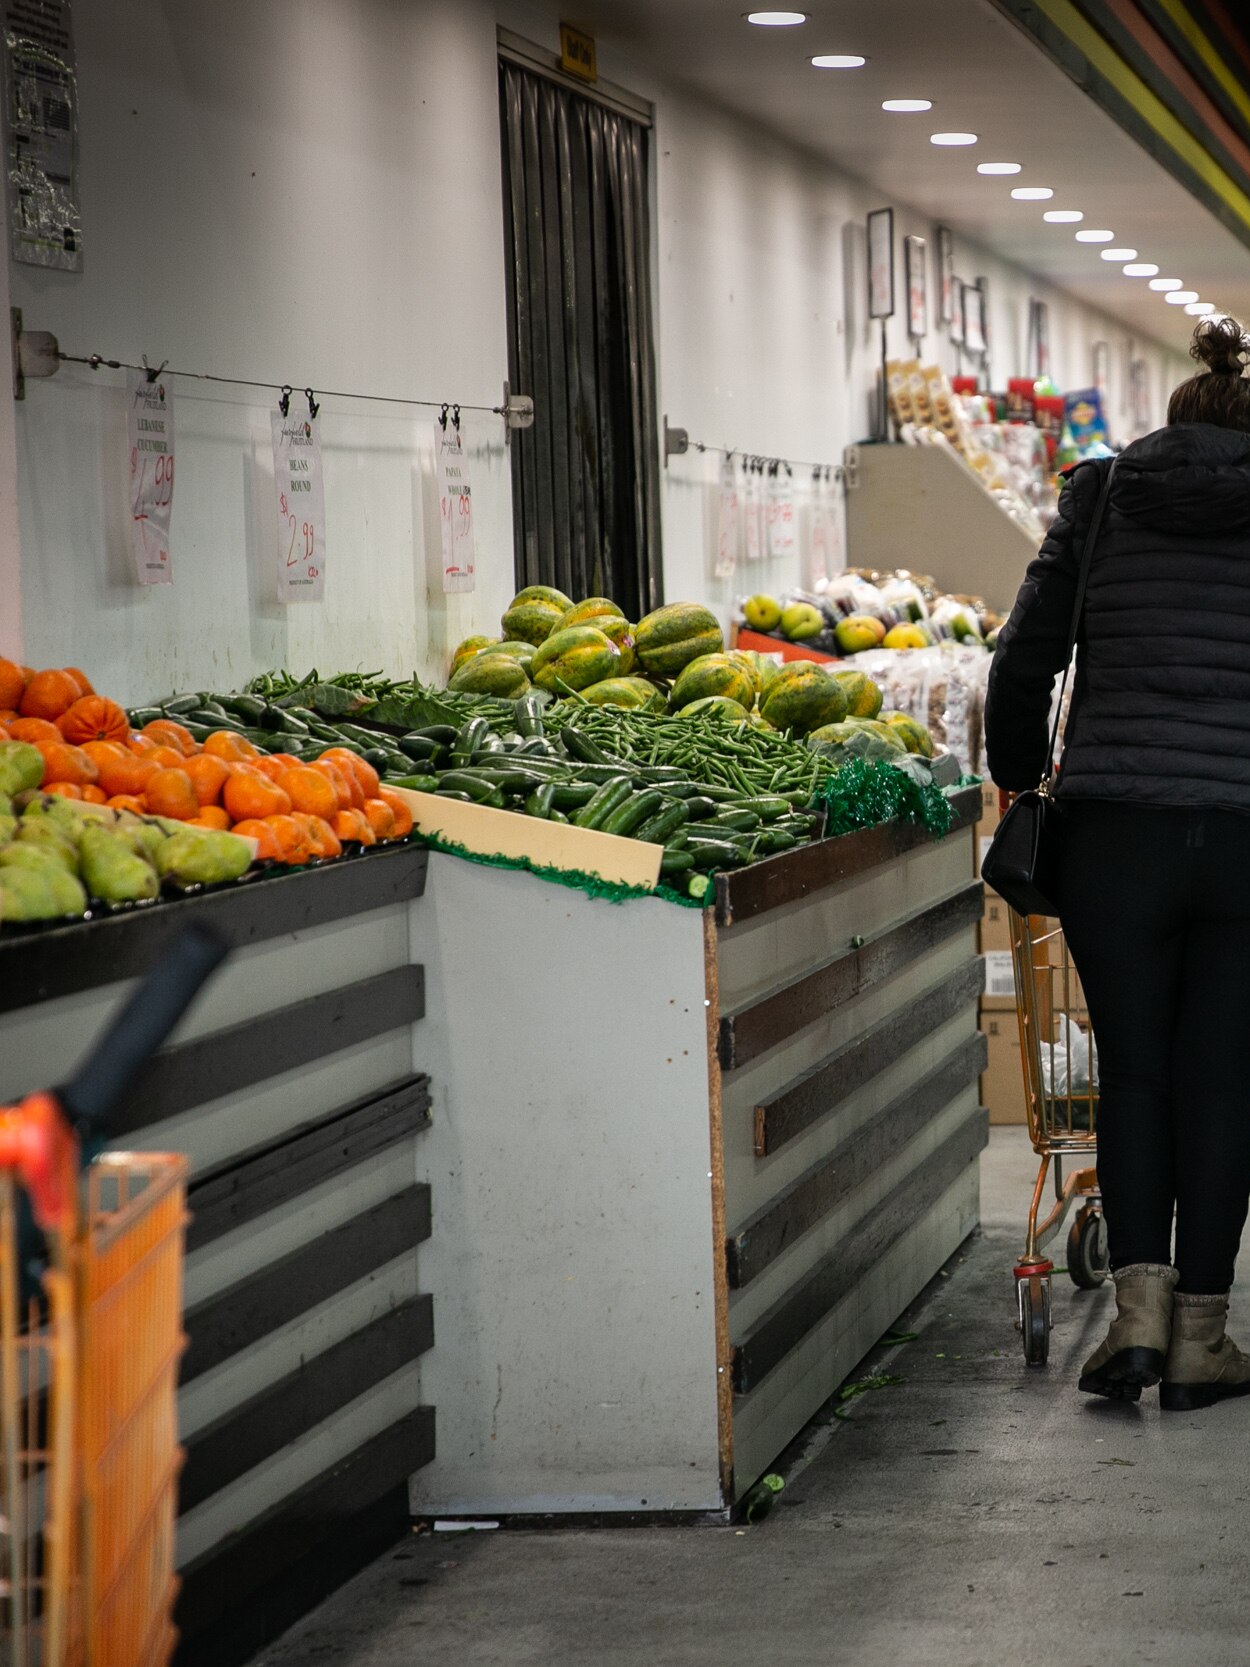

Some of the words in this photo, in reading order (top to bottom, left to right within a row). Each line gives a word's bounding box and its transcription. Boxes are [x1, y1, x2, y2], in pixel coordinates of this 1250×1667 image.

[137, 418, 166, 433] LEBANESE
[137, 438, 168, 454] CUCUMBER
[289, 459, 309, 471] BEANS
[290, 480, 312, 492] ROUND
